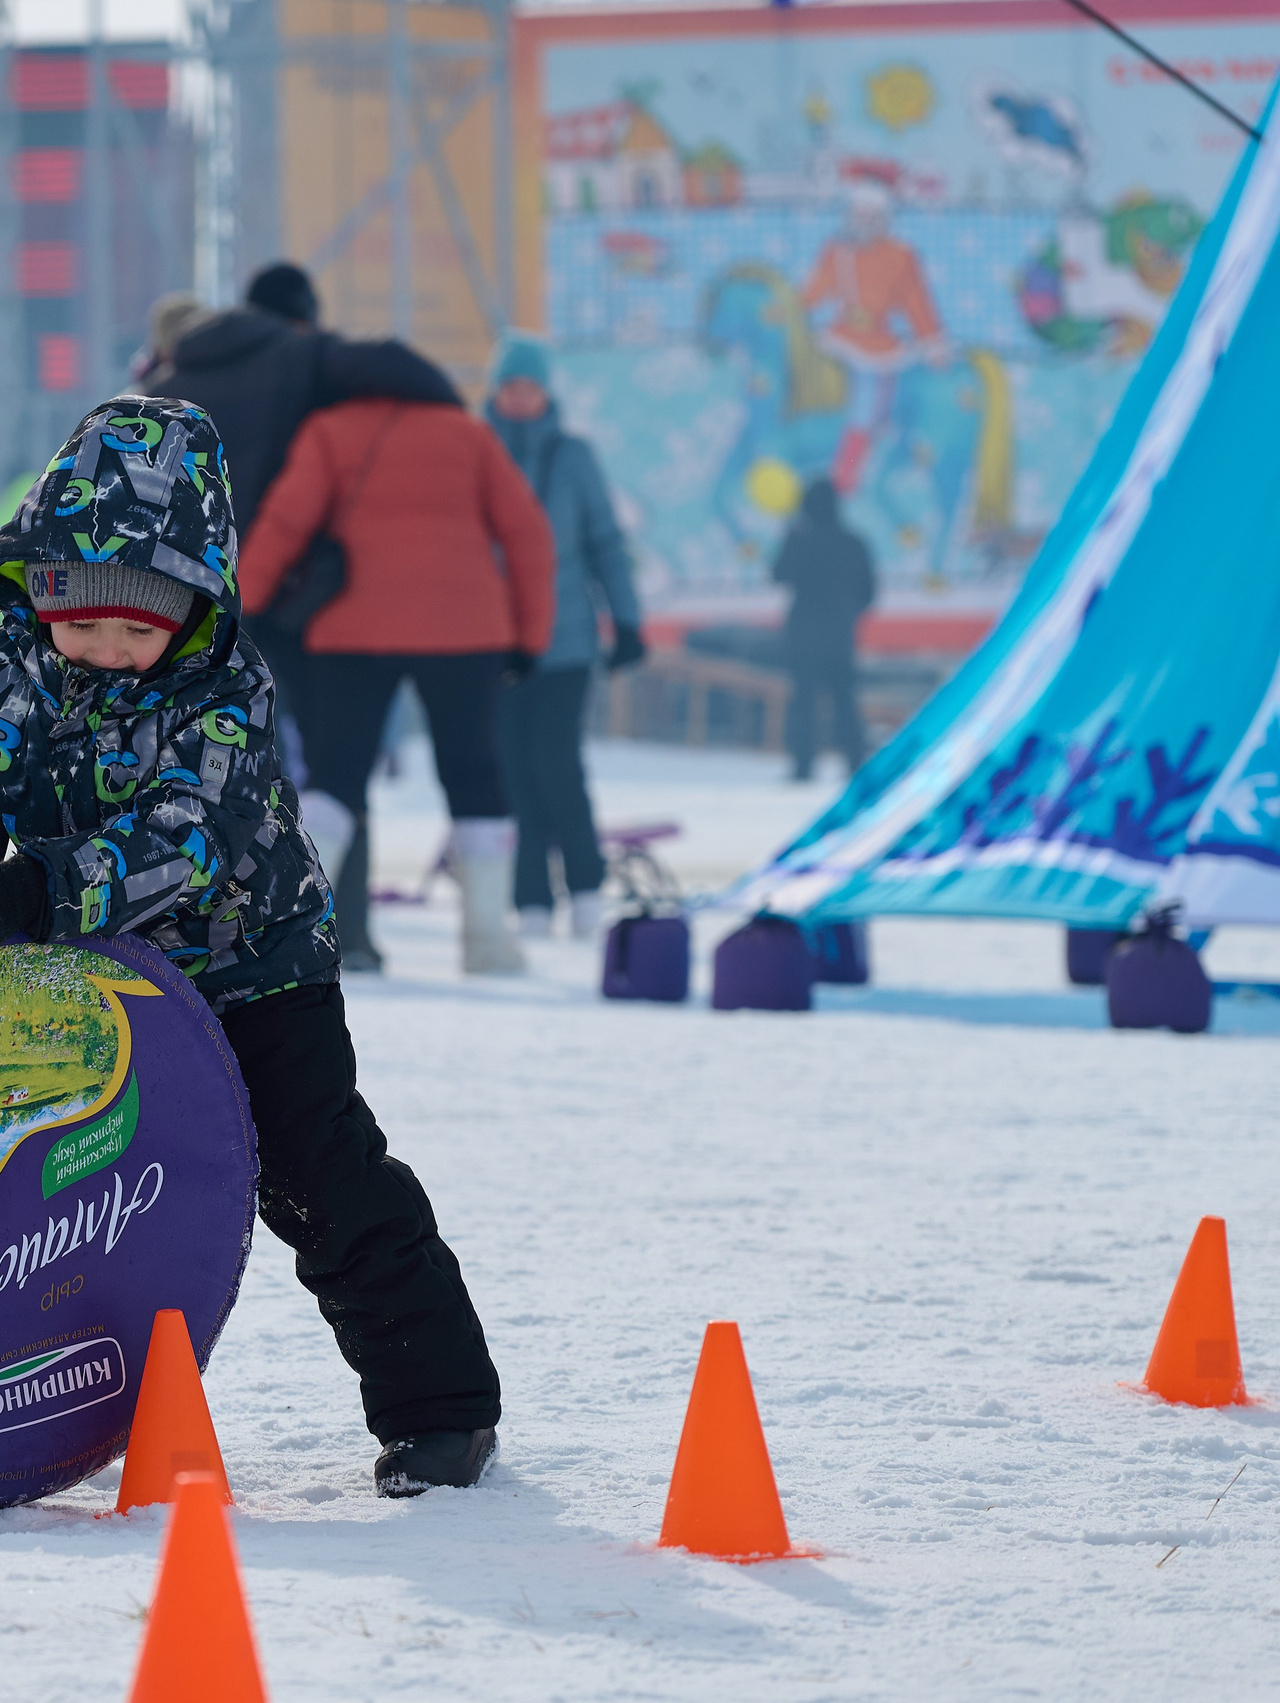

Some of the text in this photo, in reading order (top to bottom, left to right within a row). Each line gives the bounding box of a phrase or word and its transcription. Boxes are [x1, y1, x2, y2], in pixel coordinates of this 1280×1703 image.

[111, 939, 169, 983] ПРЕДГОРЬЯХ
[171, 981, 198, 1011] АЛТАЯ
[203, 1020, 218, 1040] 120
[216, 1040, 234, 1078] СУТОК
[51, 1110, 124, 1166] терпкий вкус
[56, 1132, 122, 1185] Изысканный
[40, 1274, 85, 1312] сыр
[19, 1332, 70, 1355] АЛТАЙСКИЙ
[72, 1324, 106, 1339] МАСТЕР
